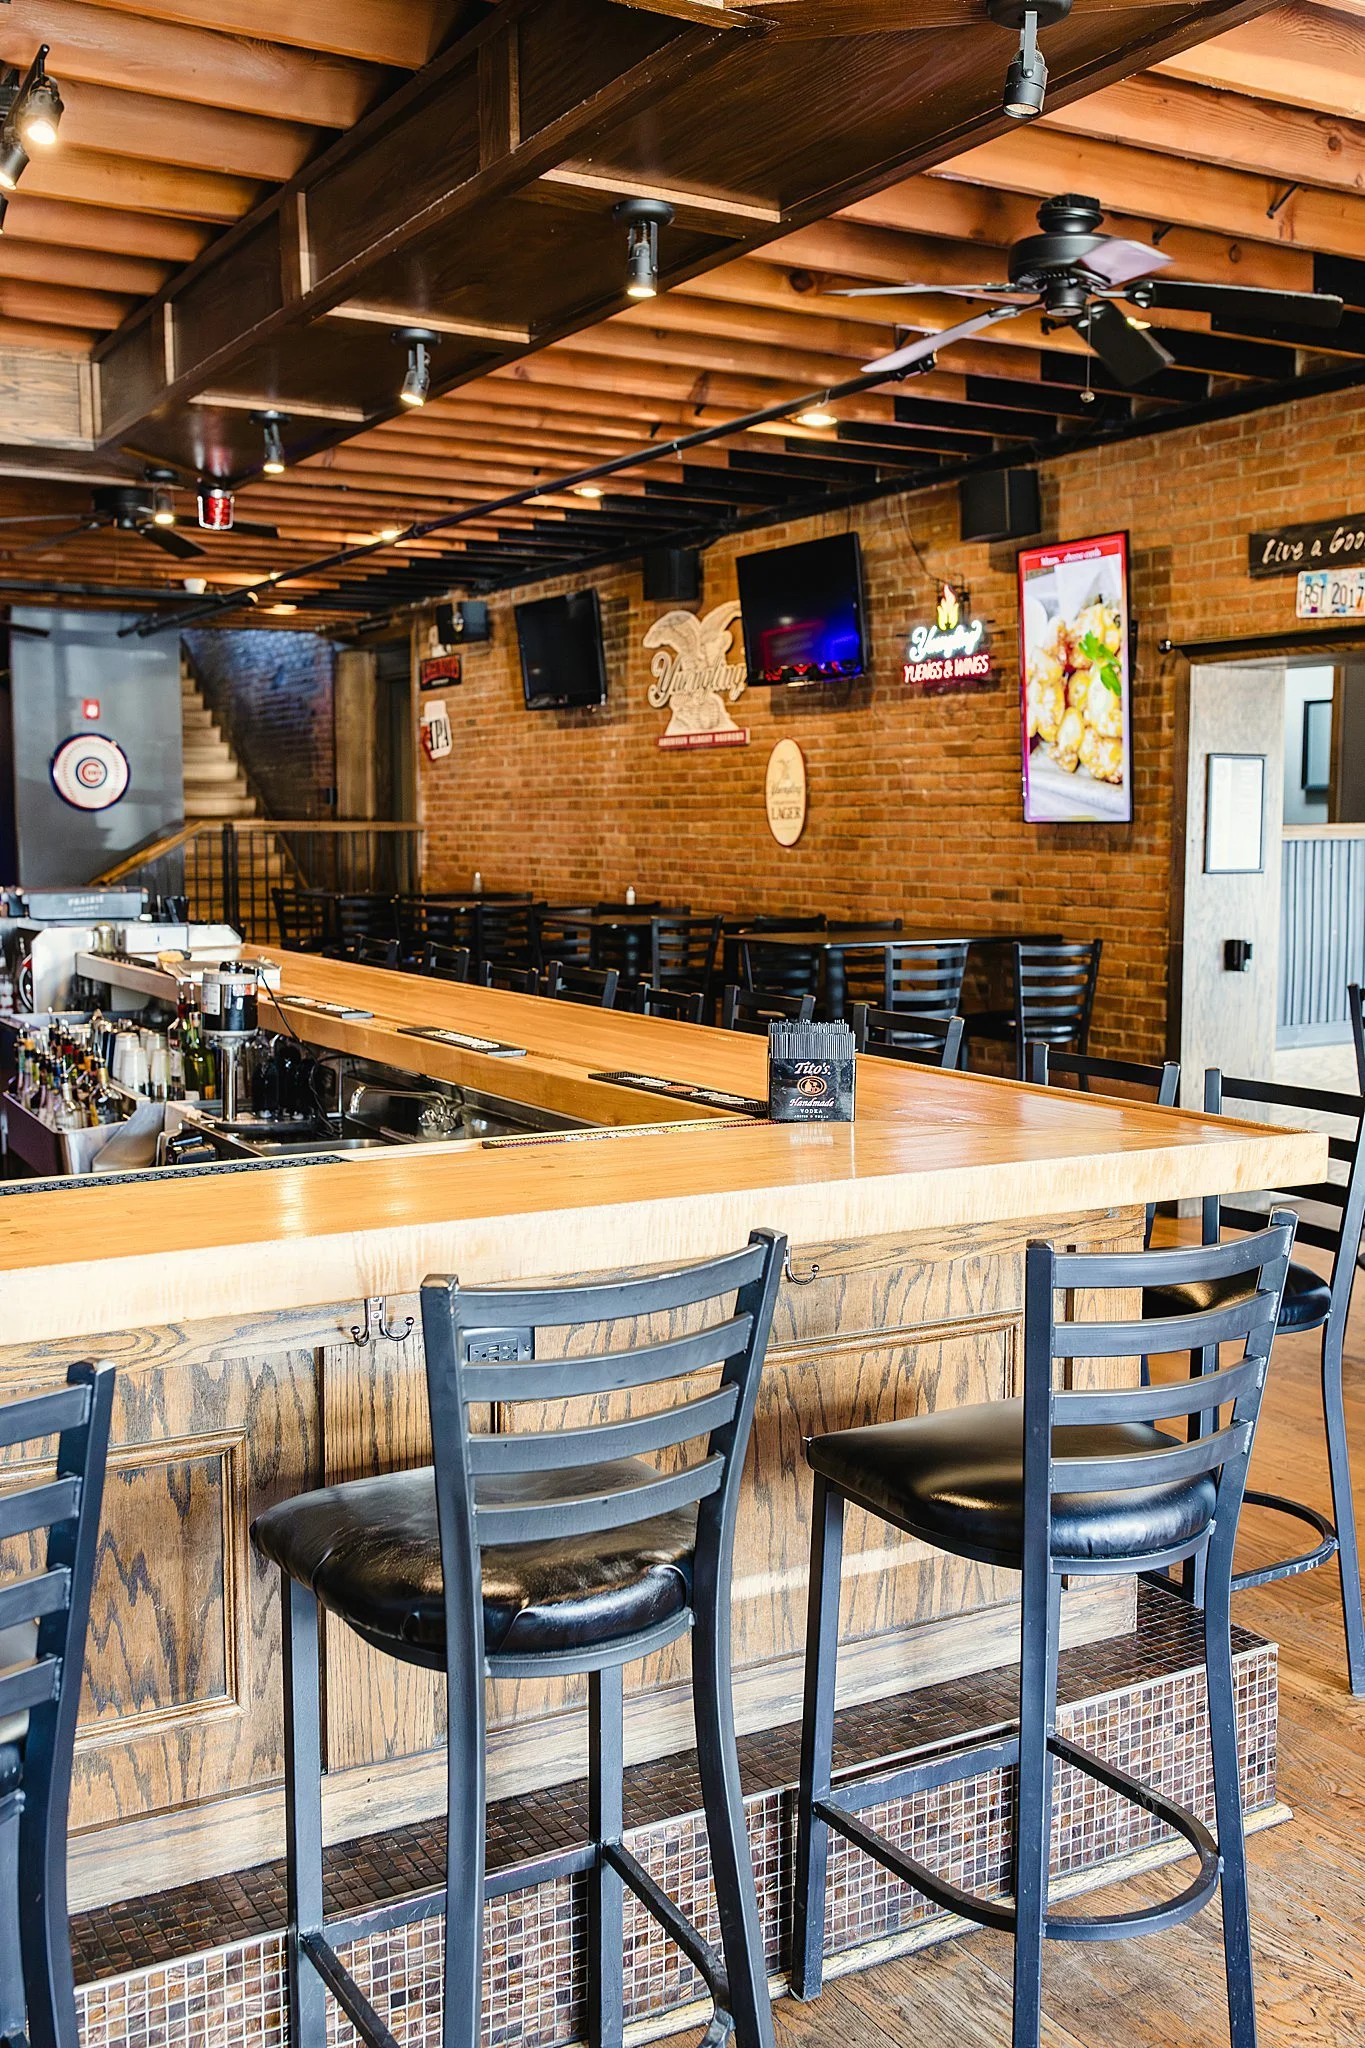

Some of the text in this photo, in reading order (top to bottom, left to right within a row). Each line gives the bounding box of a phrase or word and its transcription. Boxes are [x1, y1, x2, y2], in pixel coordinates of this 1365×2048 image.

[1262, 527, 1365, 564] Live a Goo
[1331, 582, 1364, 608] 2017
[648, 651, 747, 708] Yuengling
[943, 659, 953, 678] &
[429, 718, 450, 752] IPA
[771, 806, 801, 820] LAGER
[789, 1097, 835, 1107] Handmade
